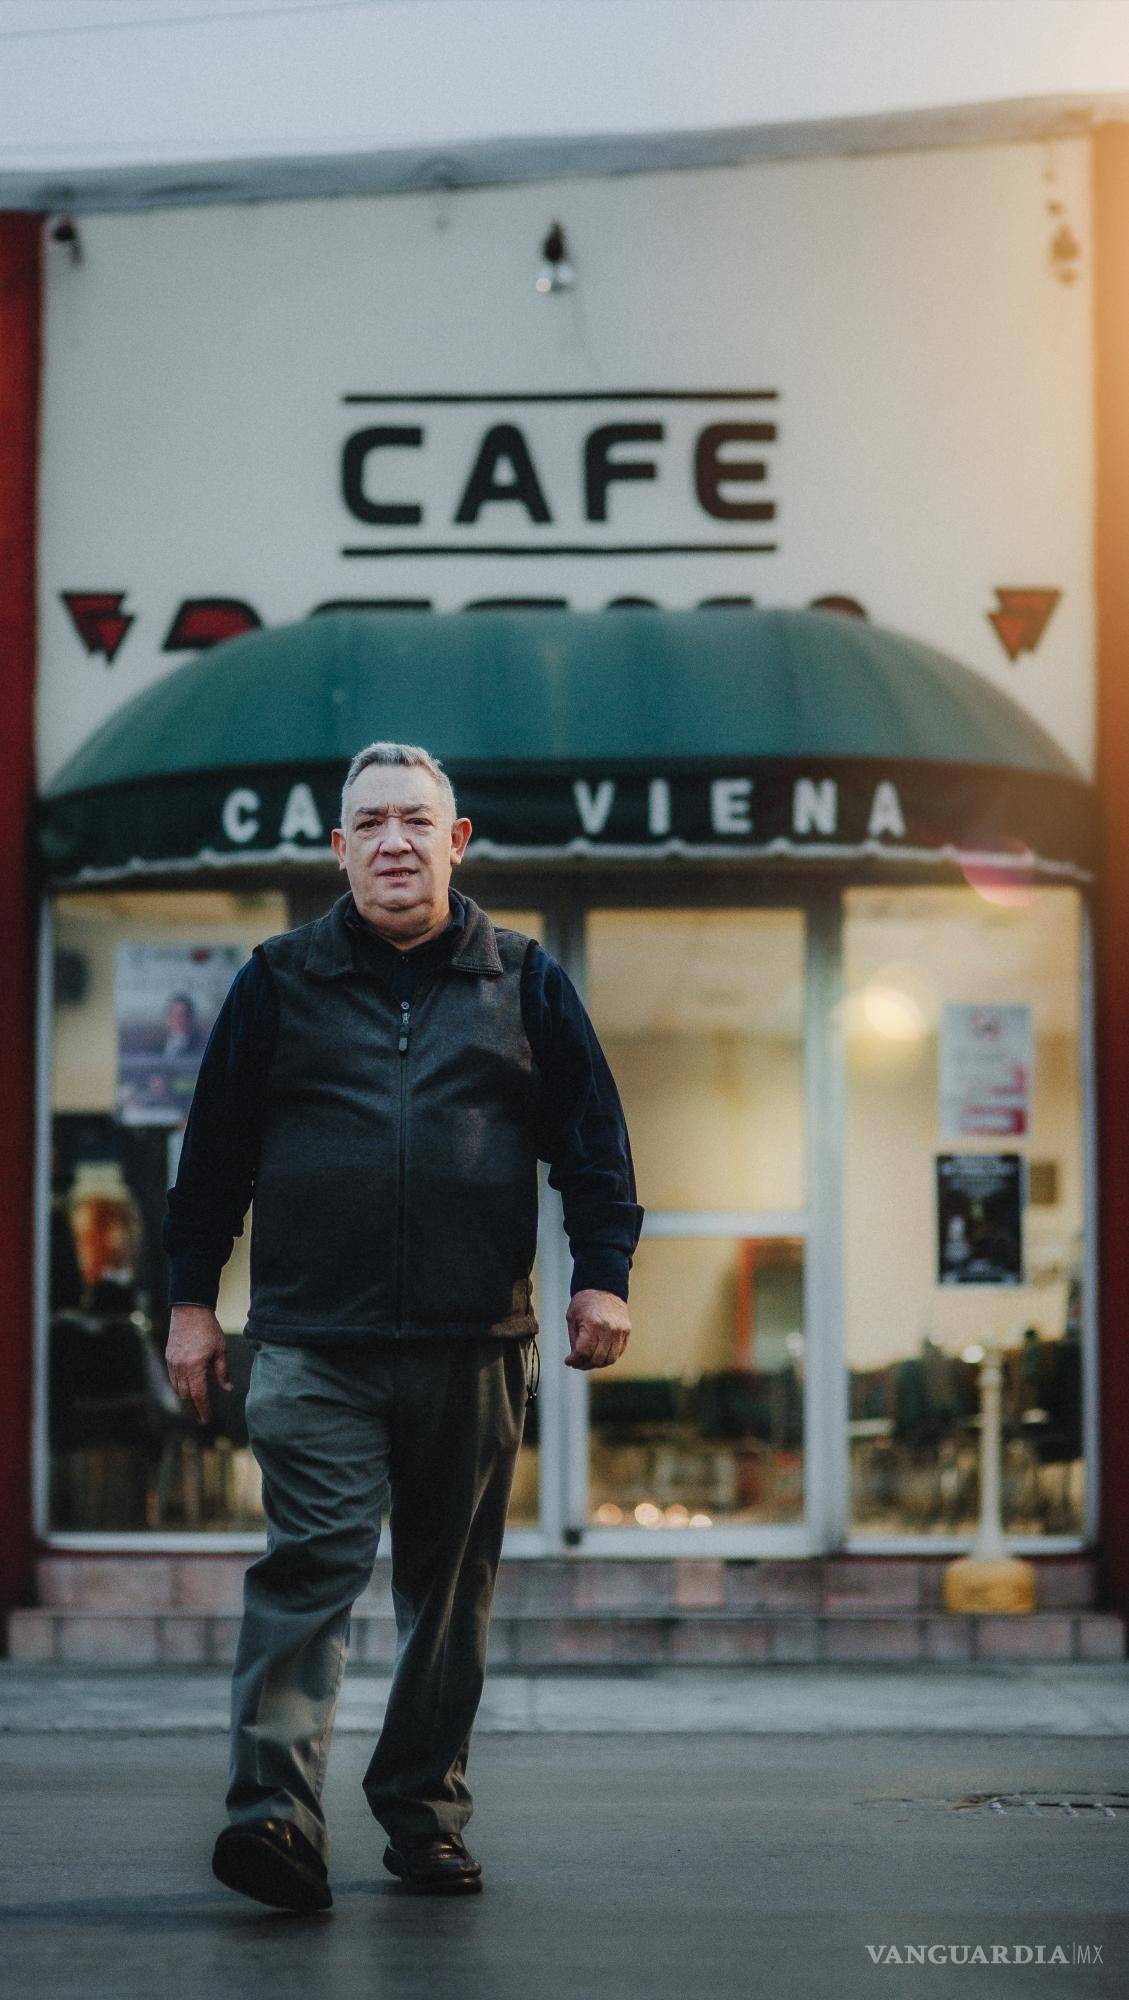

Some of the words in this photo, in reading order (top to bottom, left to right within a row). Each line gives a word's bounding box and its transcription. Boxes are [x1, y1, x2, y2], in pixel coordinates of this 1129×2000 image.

[341, 422, 777, 525] CAFE
[222, 783, 323, 843] CA
[573, 778, 906, 838] VIENA
